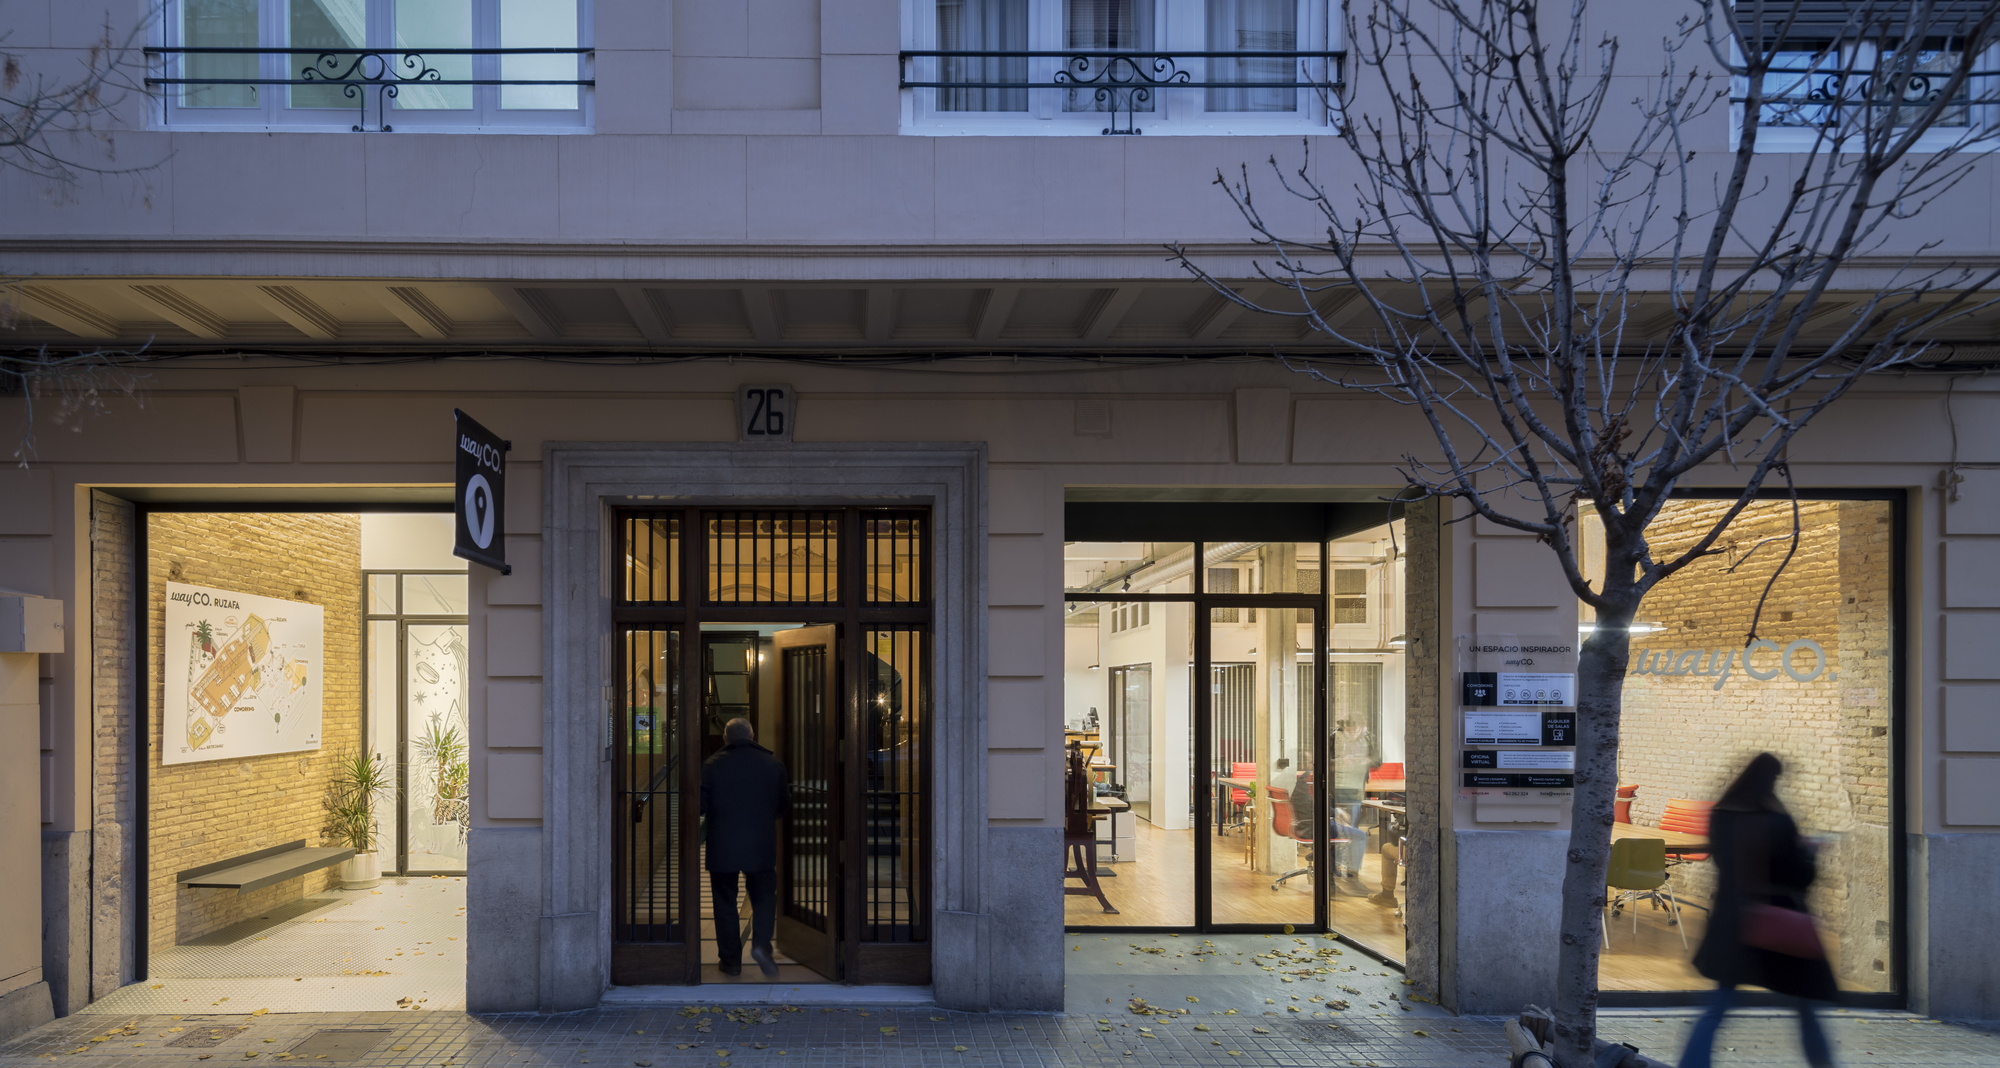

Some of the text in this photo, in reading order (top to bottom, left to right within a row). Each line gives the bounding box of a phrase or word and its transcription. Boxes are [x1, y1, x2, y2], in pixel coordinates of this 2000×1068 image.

[747, 388, 784, 436] 26
[460, 434, 502, 474] wayCO.
[170, 592, 240, 610] wayCO. RUZAFA
[1483, 645, 1518, 653] ESPACIO
[1630, 638, 1838, 691] wayCO.
